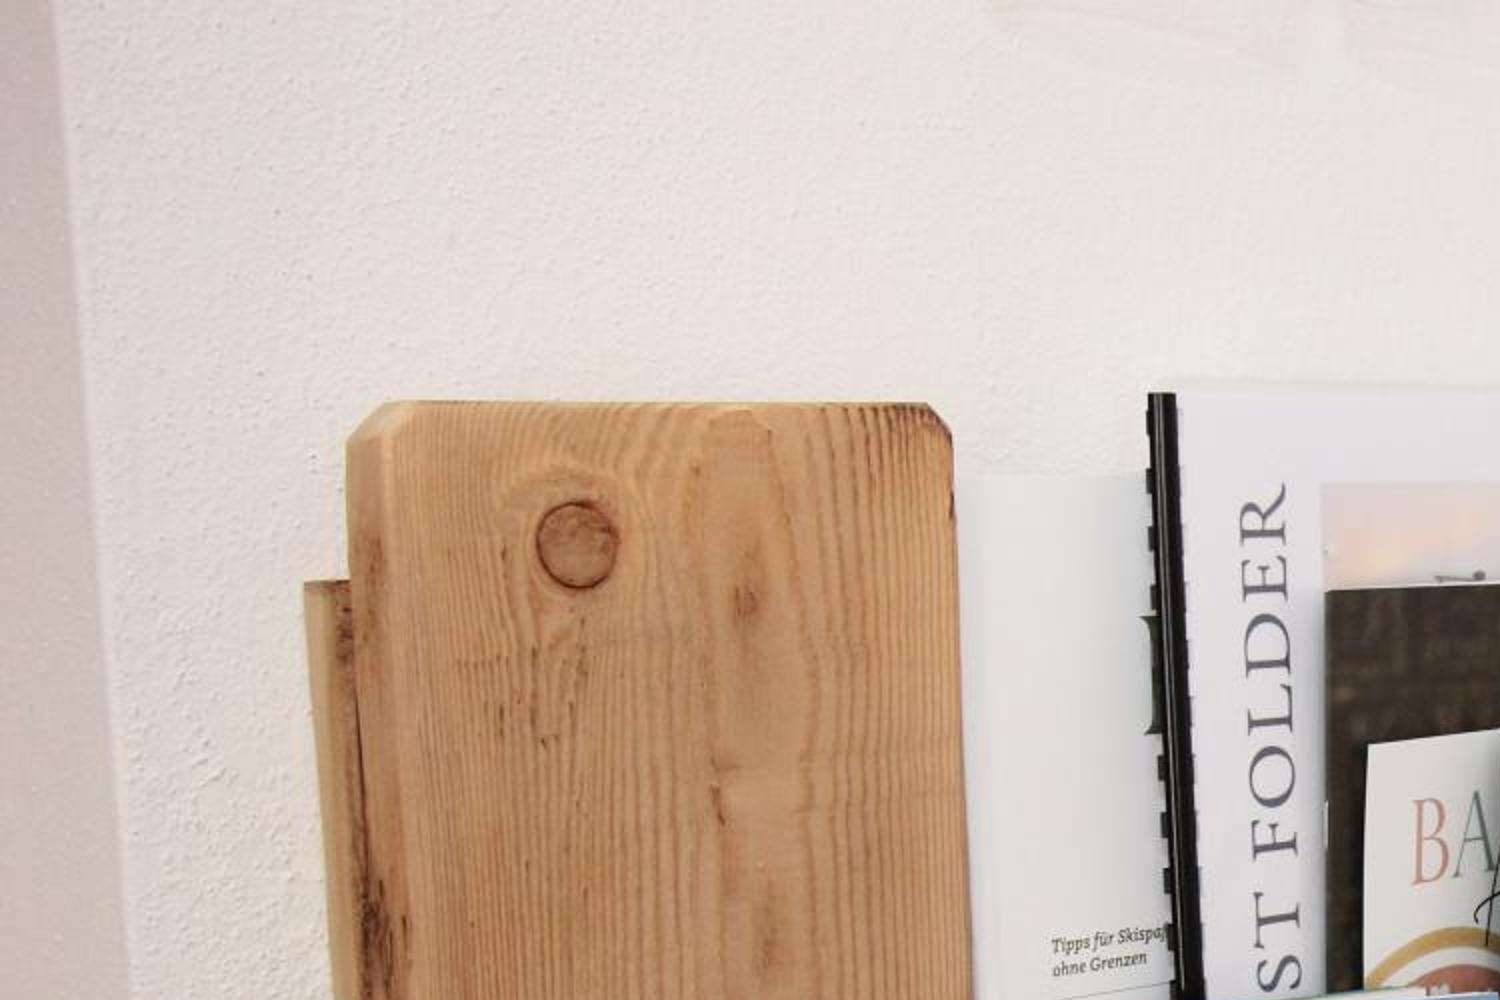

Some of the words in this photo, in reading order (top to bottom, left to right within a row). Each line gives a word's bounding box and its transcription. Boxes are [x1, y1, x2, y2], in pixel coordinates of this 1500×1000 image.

[1238, 482, 1299, 861] FOLDER
[1051, 936, 1091, 956] Tipps
[1092, 931, 1115, 952] für
[1052, 961, 1087, 978] ohne
[1089, 952, 1148, 972] Grenzen
